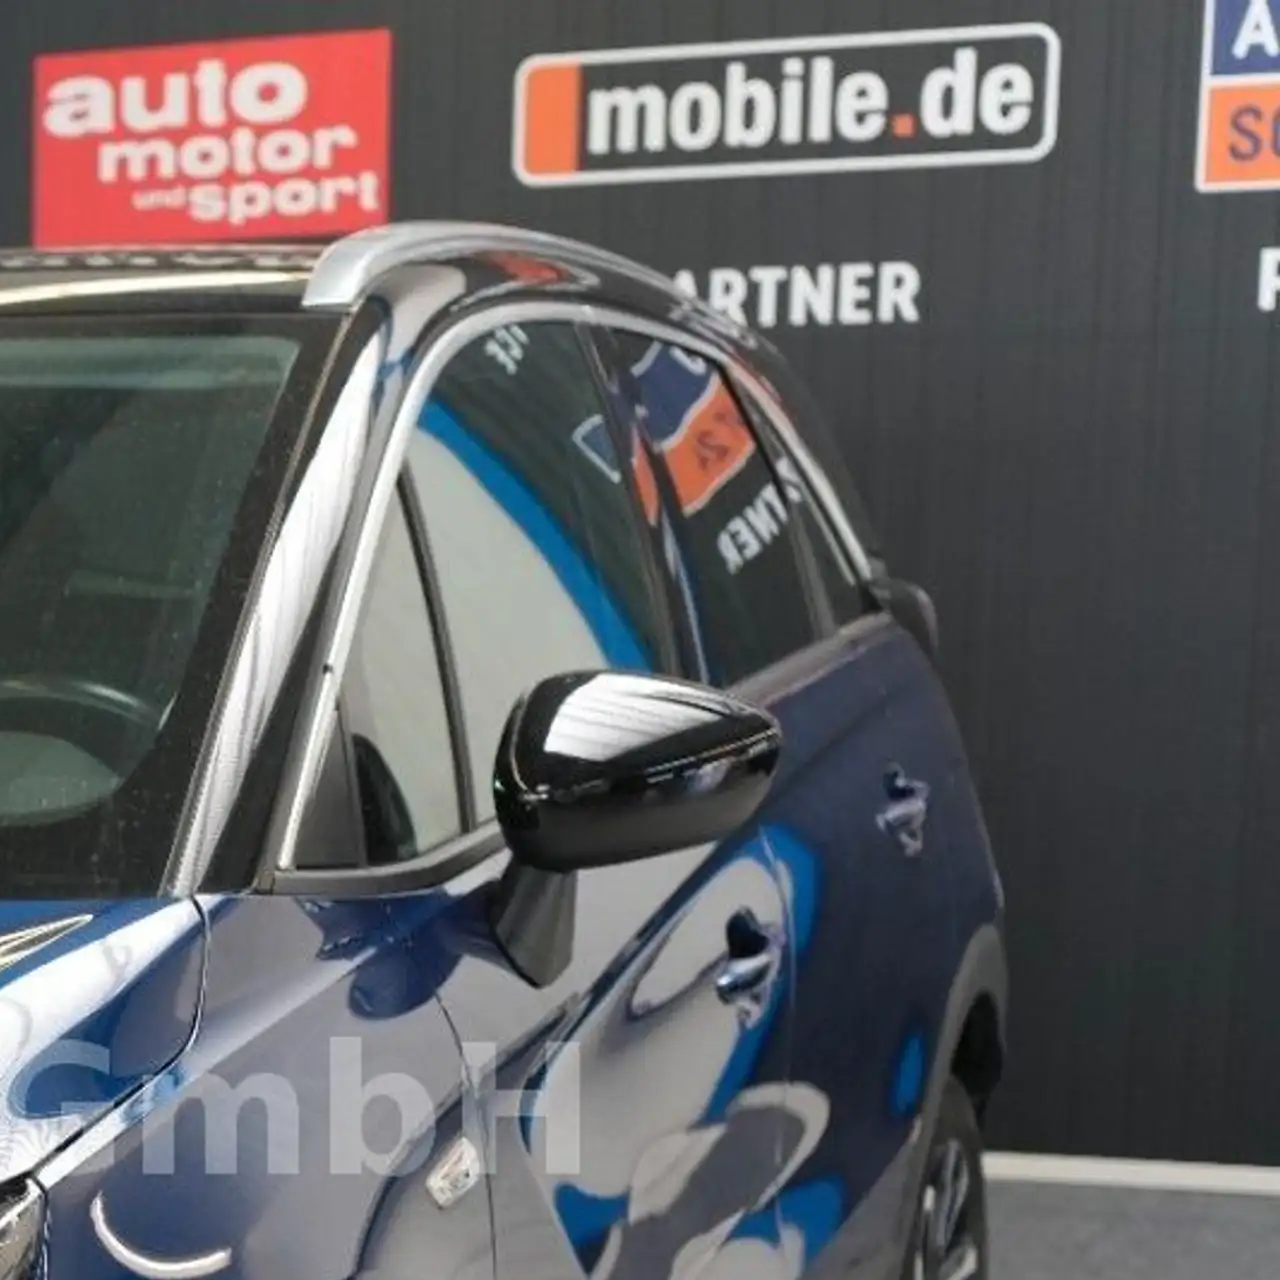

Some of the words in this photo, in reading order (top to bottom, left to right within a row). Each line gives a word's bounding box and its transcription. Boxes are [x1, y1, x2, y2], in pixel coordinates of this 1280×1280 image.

[42, 58, 308, 138] auto
[586, 46, 1034, 156] mobile.de
[97, 124, 358, 183] motor
[187, 169, 379, 226] sport
